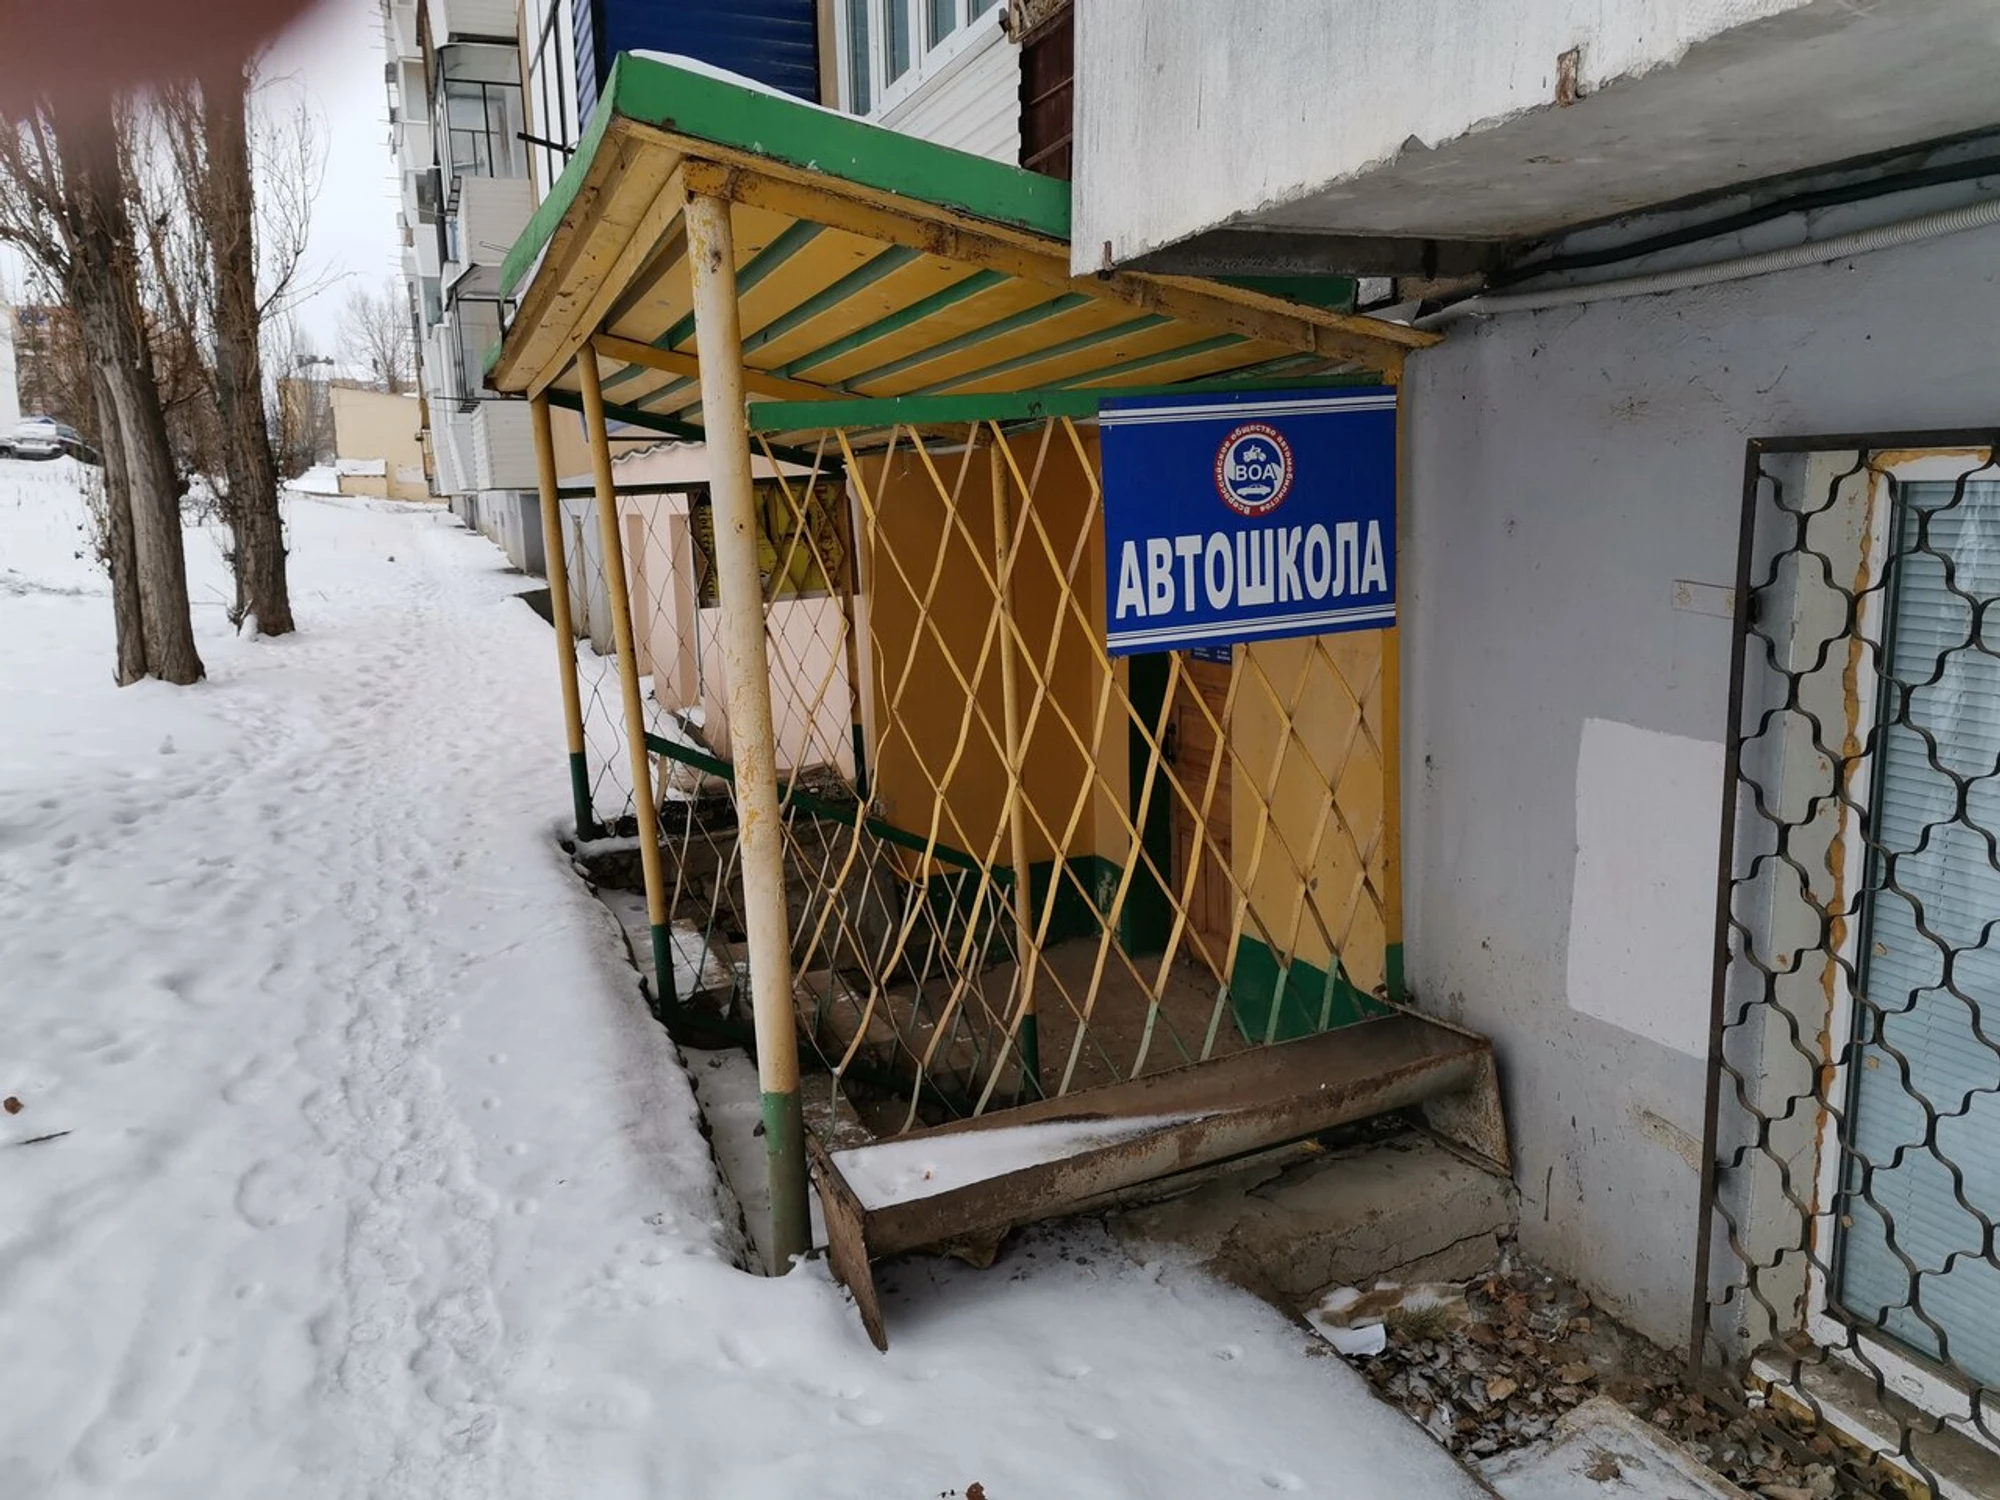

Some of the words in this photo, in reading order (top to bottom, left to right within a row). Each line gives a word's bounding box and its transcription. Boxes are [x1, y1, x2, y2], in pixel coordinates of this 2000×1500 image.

[1231, 424, 1276, 440] общество
[1236, 464, 1276, 481] ВОА
[1115, 520, 1387, 619] АВТОШКОЛА
